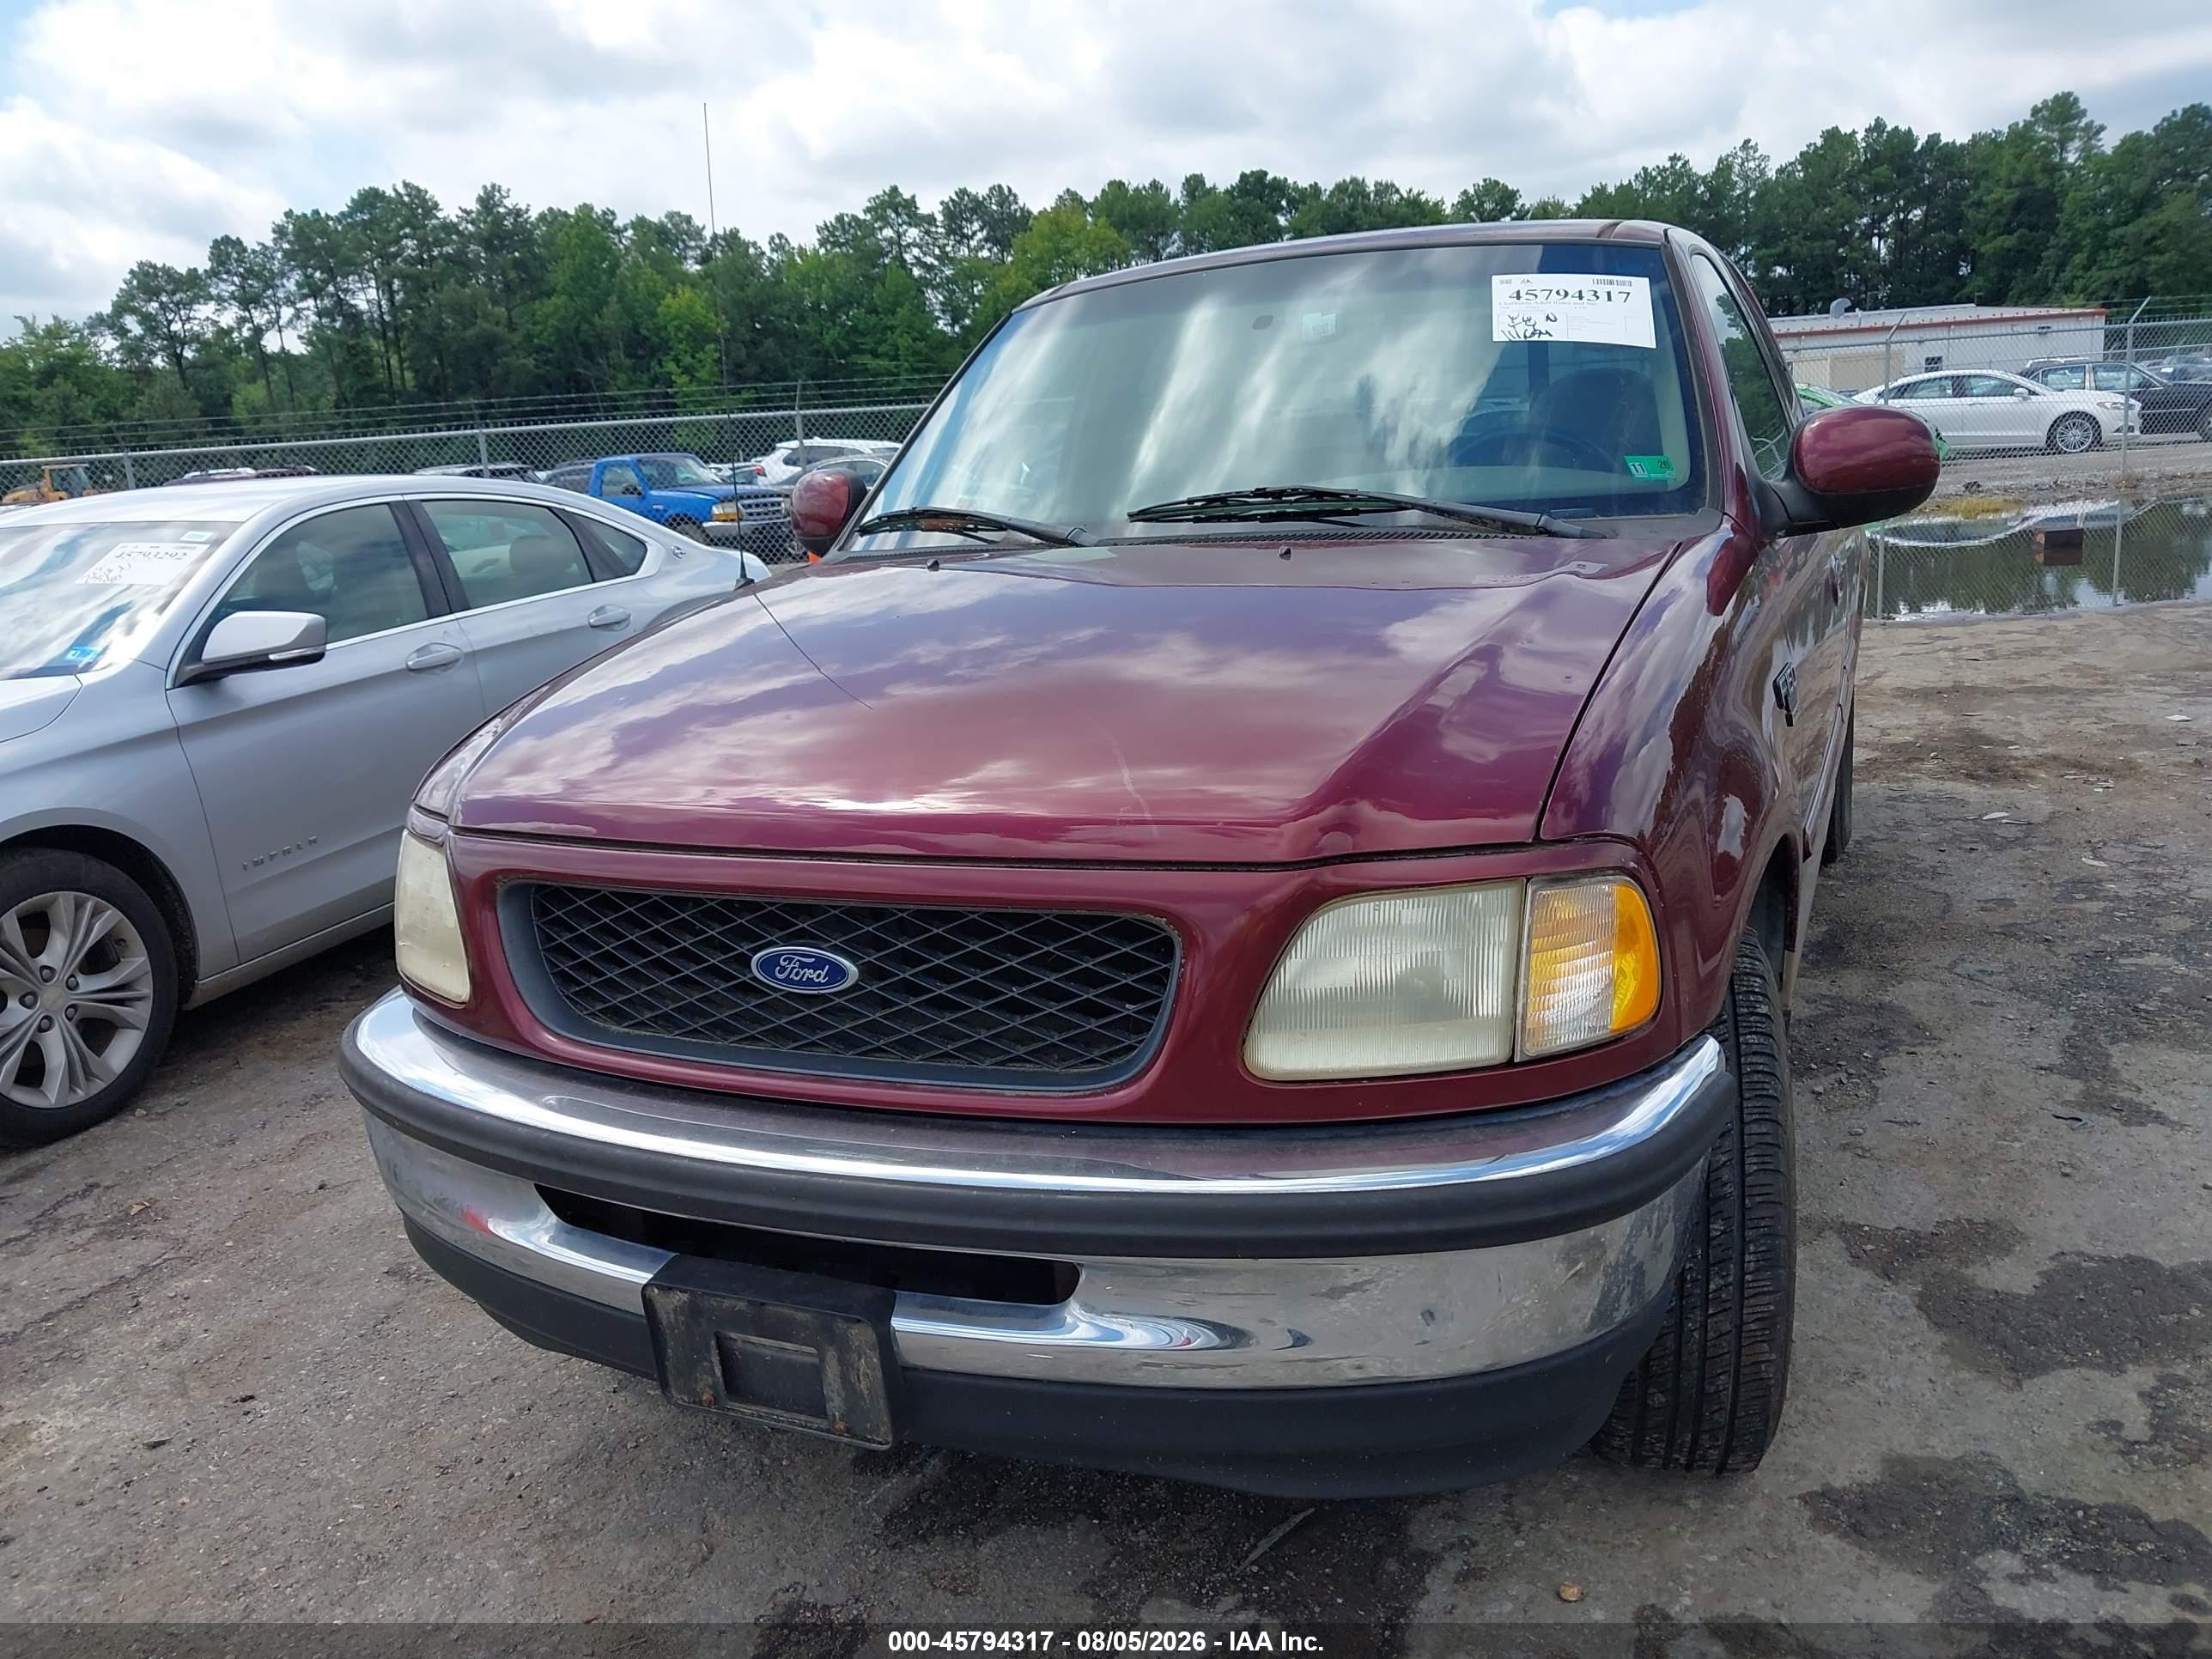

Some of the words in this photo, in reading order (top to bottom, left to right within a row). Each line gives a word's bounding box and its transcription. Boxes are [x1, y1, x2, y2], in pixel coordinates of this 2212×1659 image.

[1509, 289, 1631, 303] 45794317
[1631, 463, 1645, 473] 11
[775, 954, 830, 983] Ford
